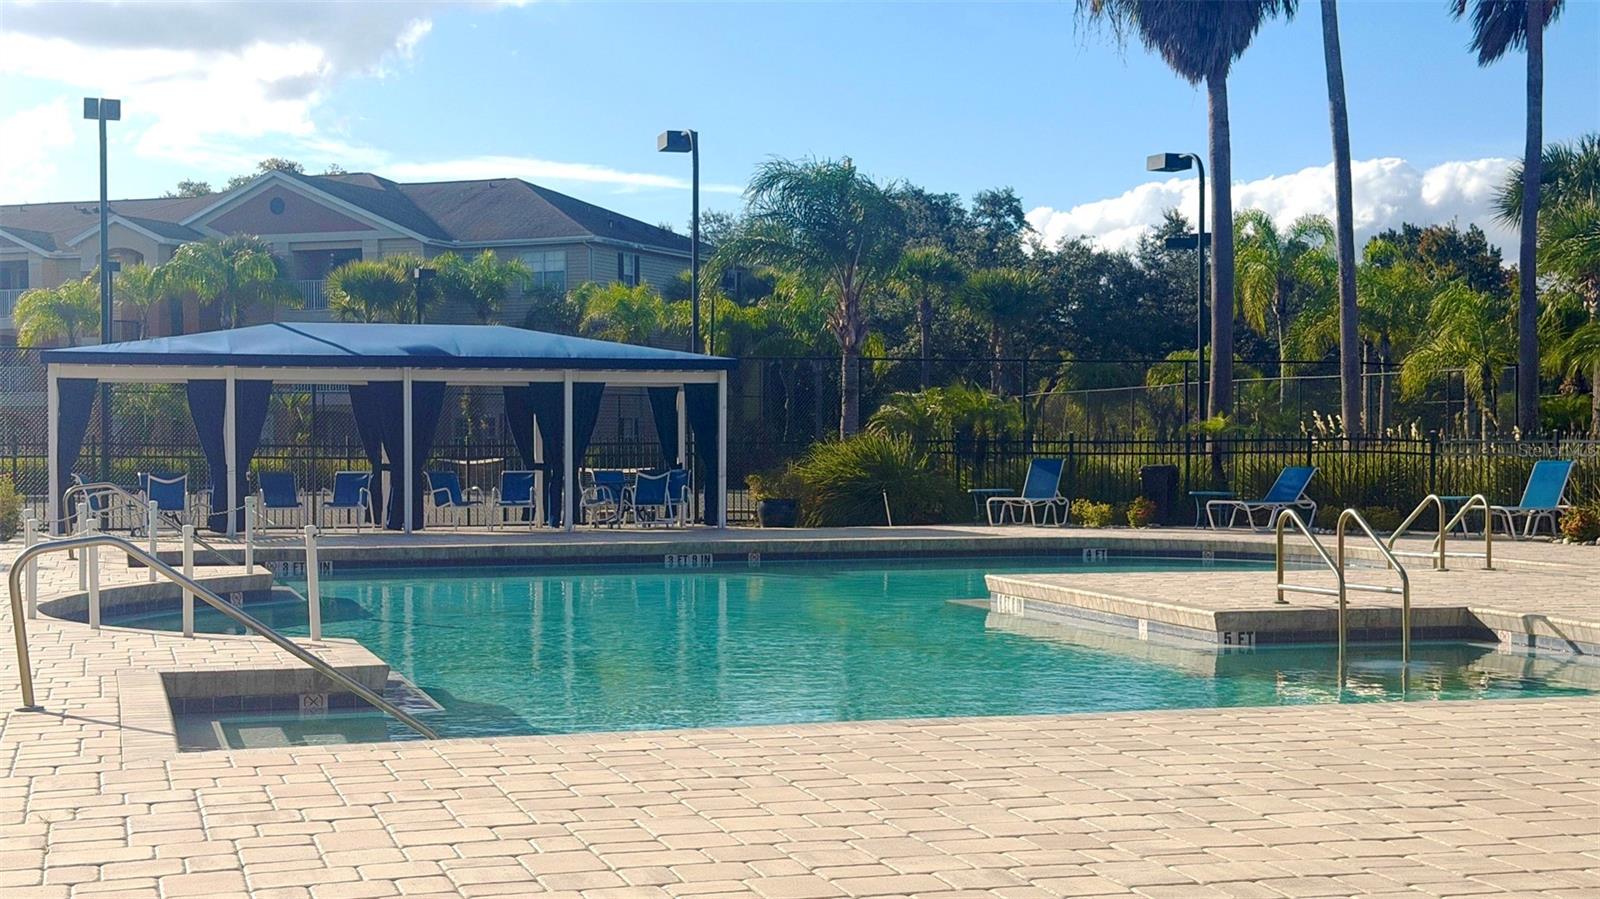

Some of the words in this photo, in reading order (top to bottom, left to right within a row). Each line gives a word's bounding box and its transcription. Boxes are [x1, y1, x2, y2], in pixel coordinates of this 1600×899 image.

[293, 562, 305, 575] FT
[1224, 631, 1232, 645] 5
[1238, 631, 1254, 646] FT
